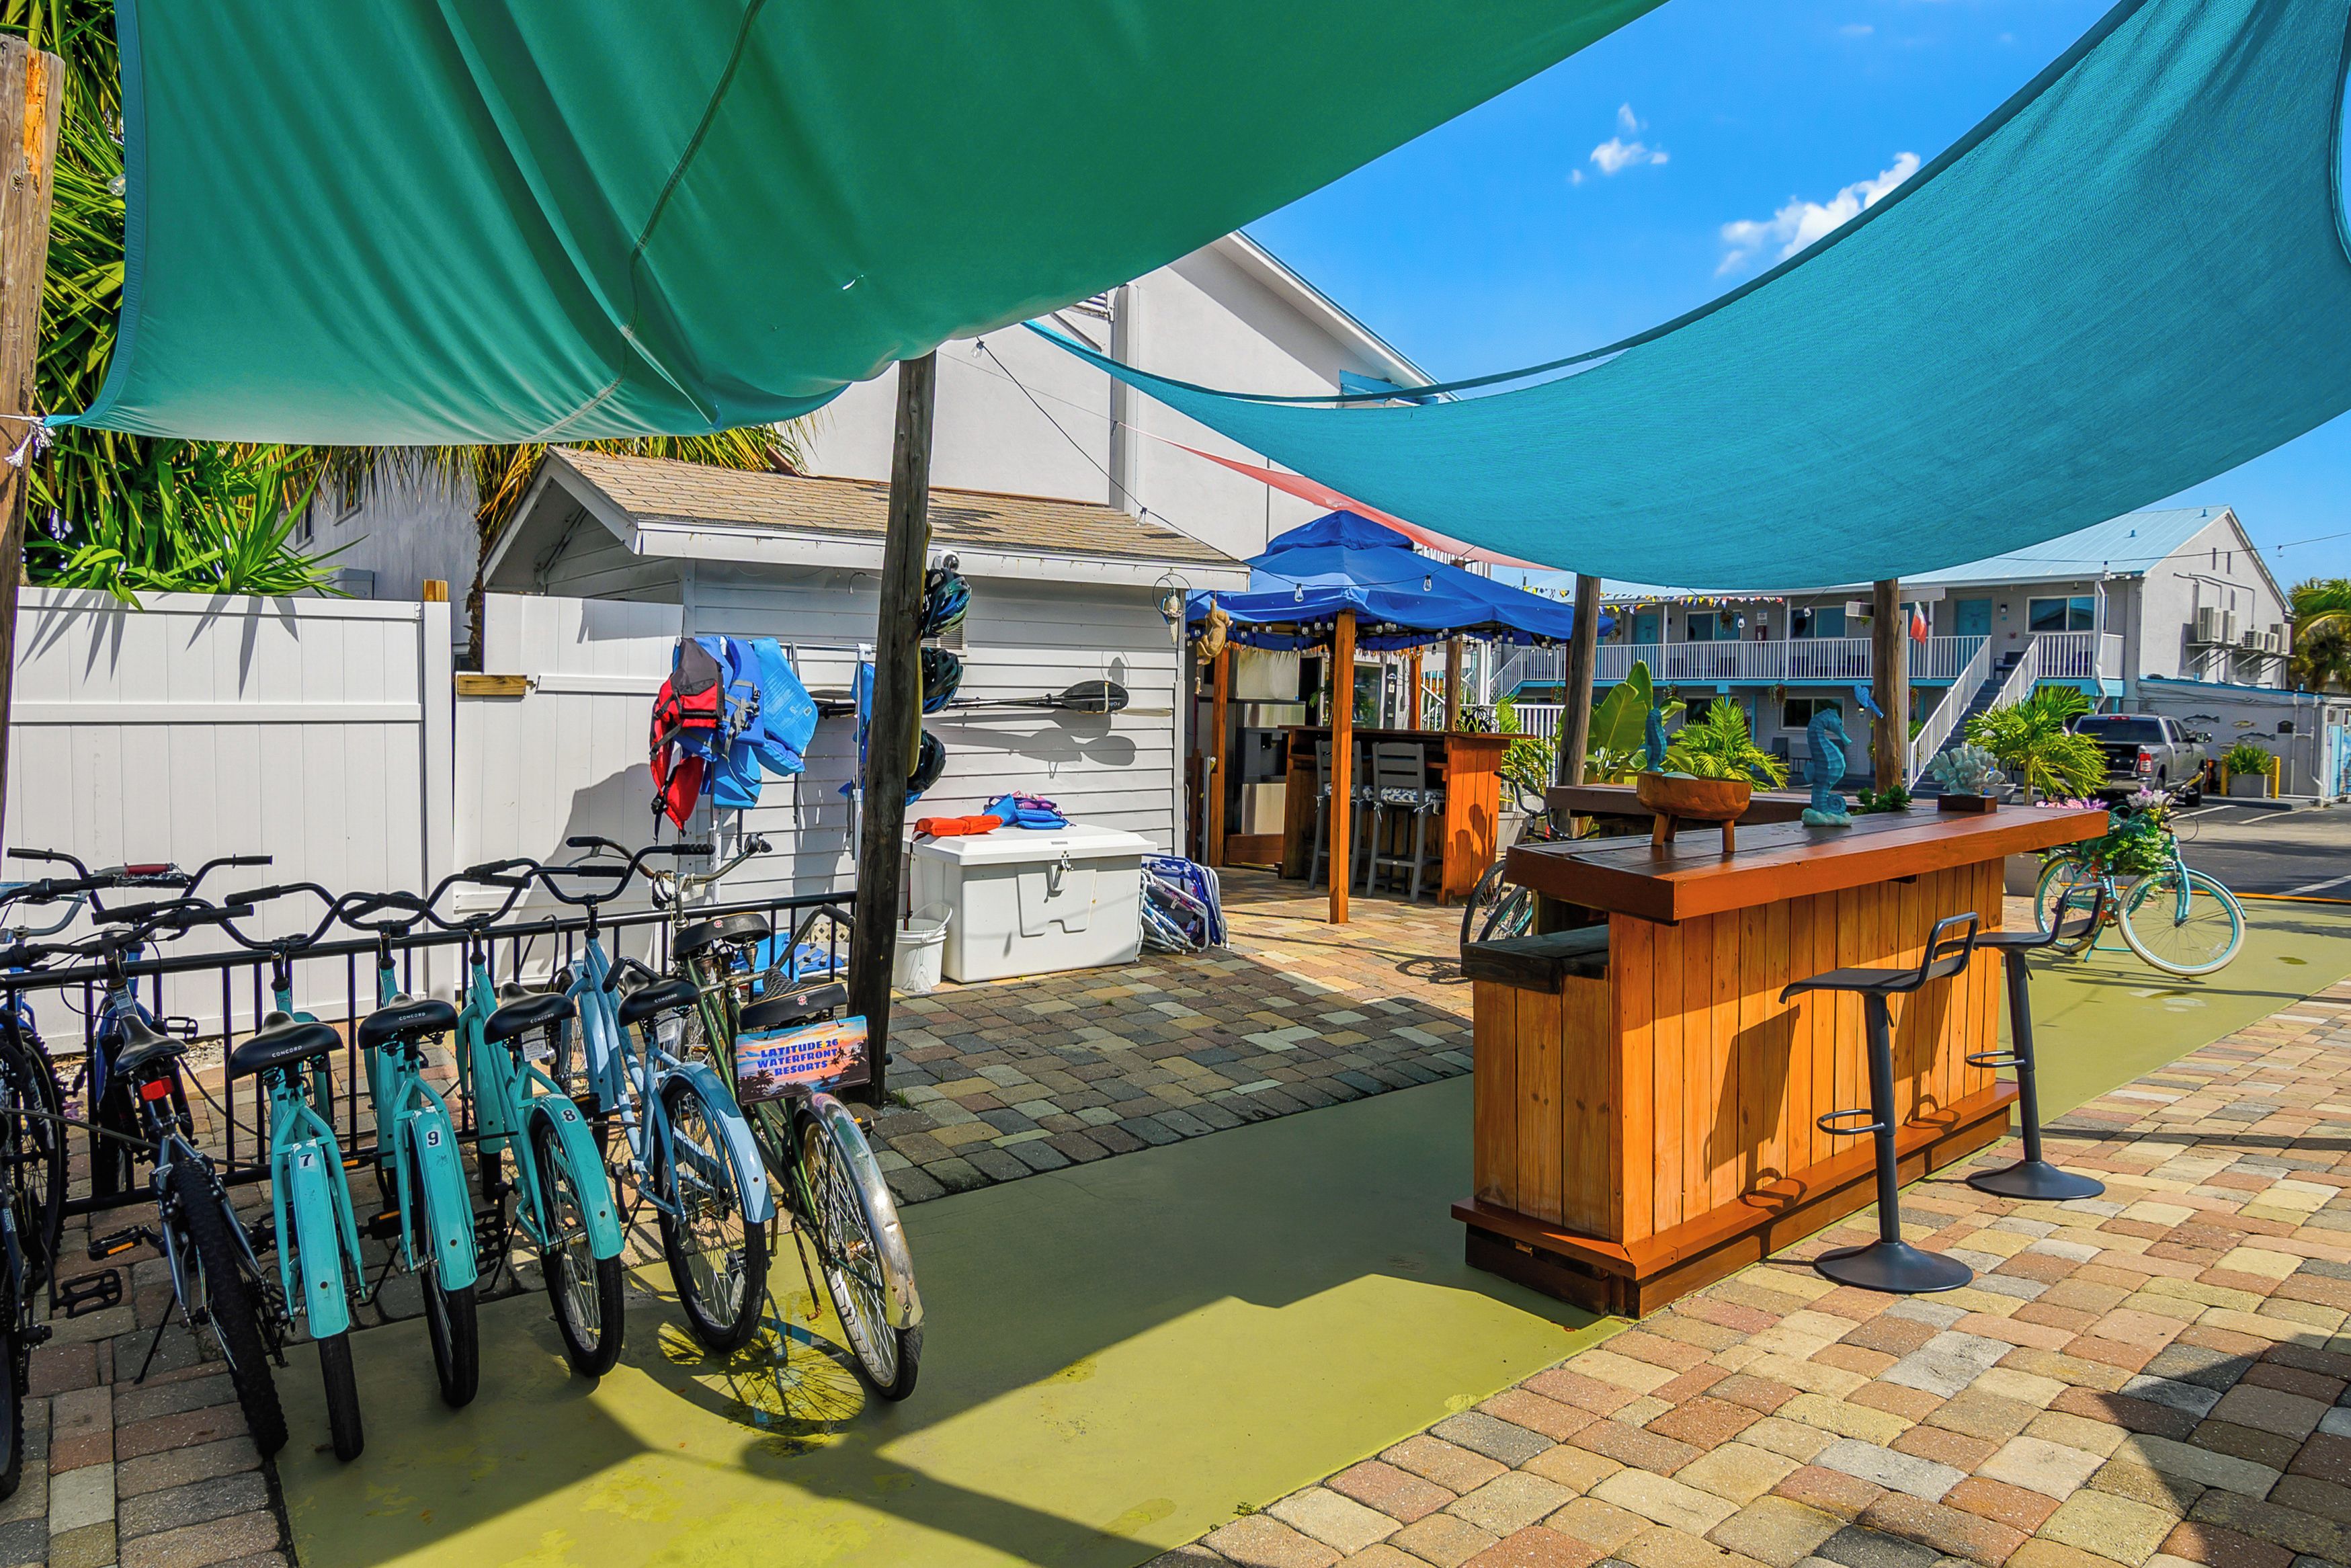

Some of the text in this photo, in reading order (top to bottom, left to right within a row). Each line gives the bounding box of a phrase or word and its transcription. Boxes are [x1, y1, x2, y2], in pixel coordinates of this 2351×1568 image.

[655, 993, 677, 1003] CONCORD
[399, 1012, 425, 1021] CONCORD
[530, 1013, 554, 1024] CONCORD
[272, 1046, 302, 1057] CONCORD
[761, 1039, 838, 1058] LATITUDE 26
[757, 1048, 837, 1068] WATERFRONT
[775, 1061, 827, 1076] RESORTS
[563, 1110, 575, 1121] 8
[428, 1131, 438, 1145] 9
[300, 1153, 311, 1167] 7
